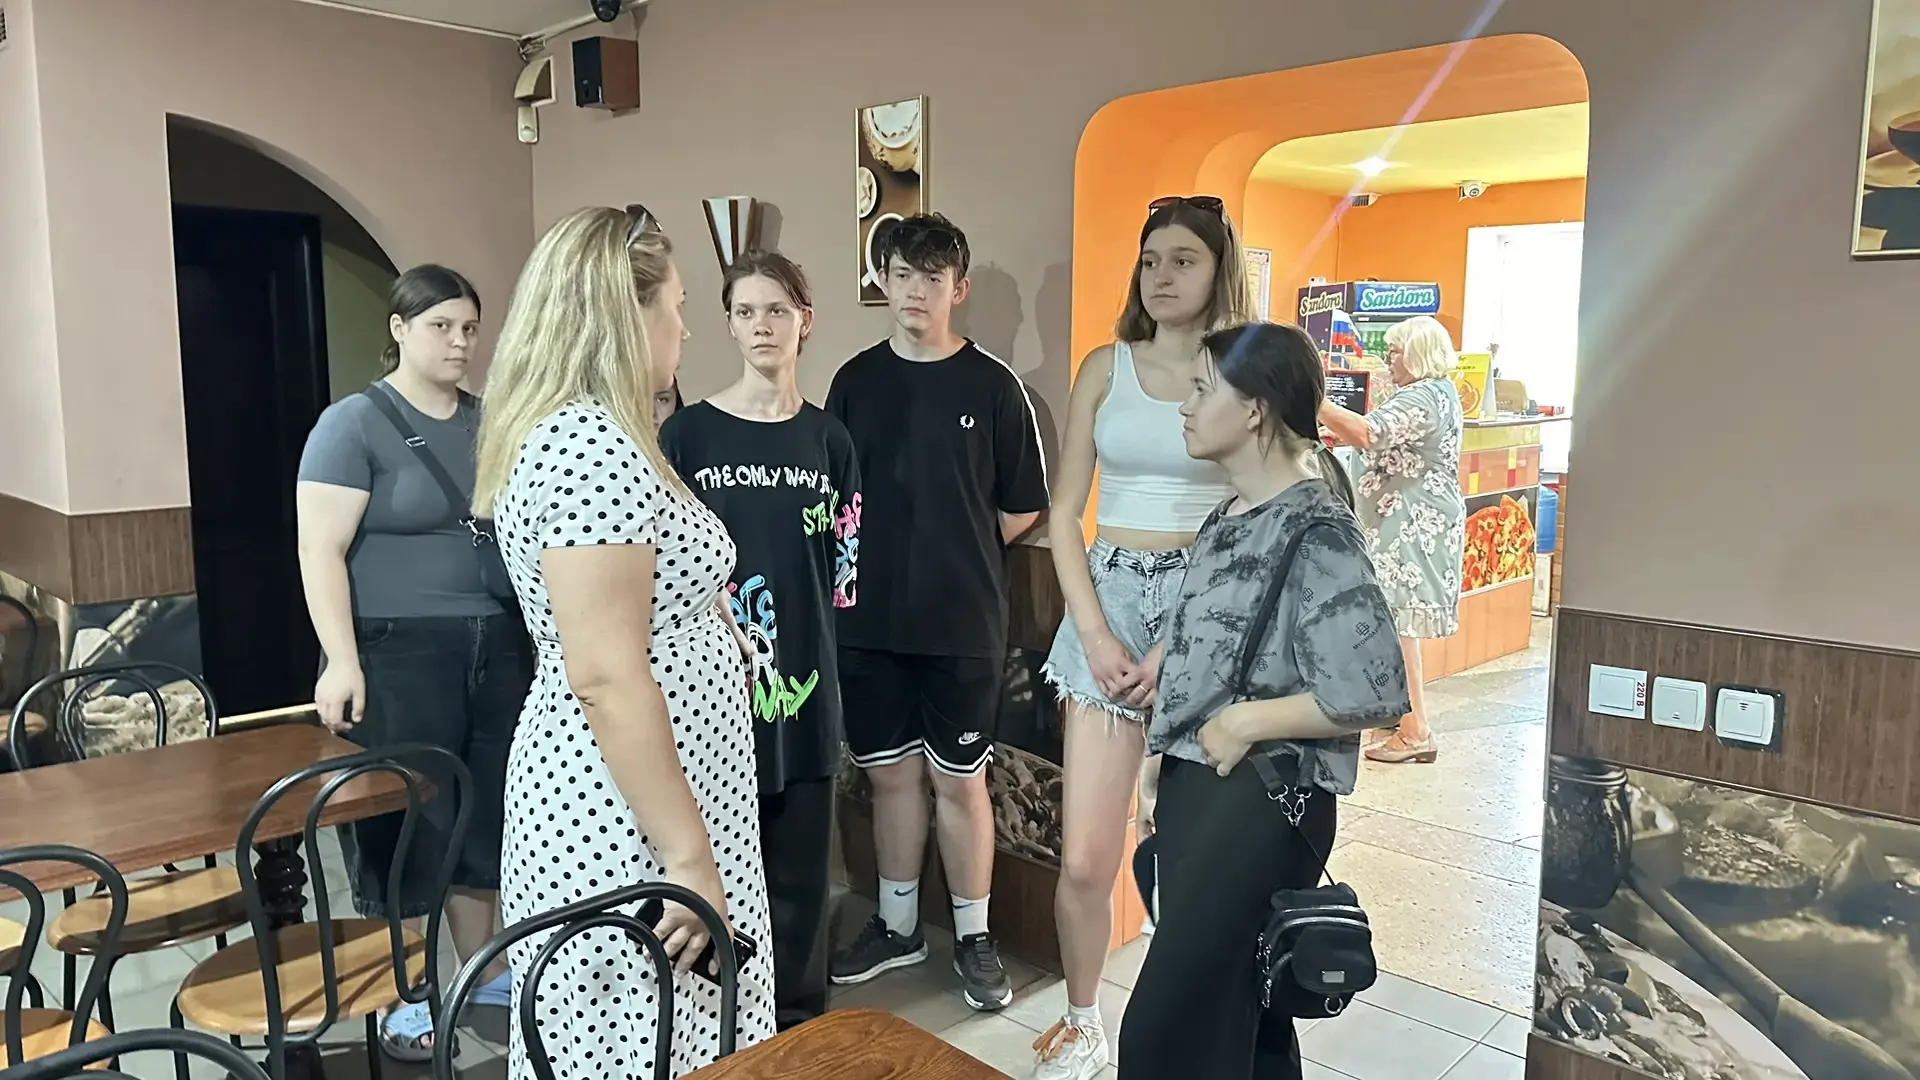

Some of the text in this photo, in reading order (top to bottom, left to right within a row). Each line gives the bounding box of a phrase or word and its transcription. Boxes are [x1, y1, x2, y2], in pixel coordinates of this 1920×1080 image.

[1300, 291, 1343, 316] Sandora
[1360, 286, 1433, 311] Sandora
[695, 465, 736, 490] THE
[735, 464, 781, 488] ONLY
[784, 466, 818, 489] WAY
[1636, 682, 1645, 698] 220
